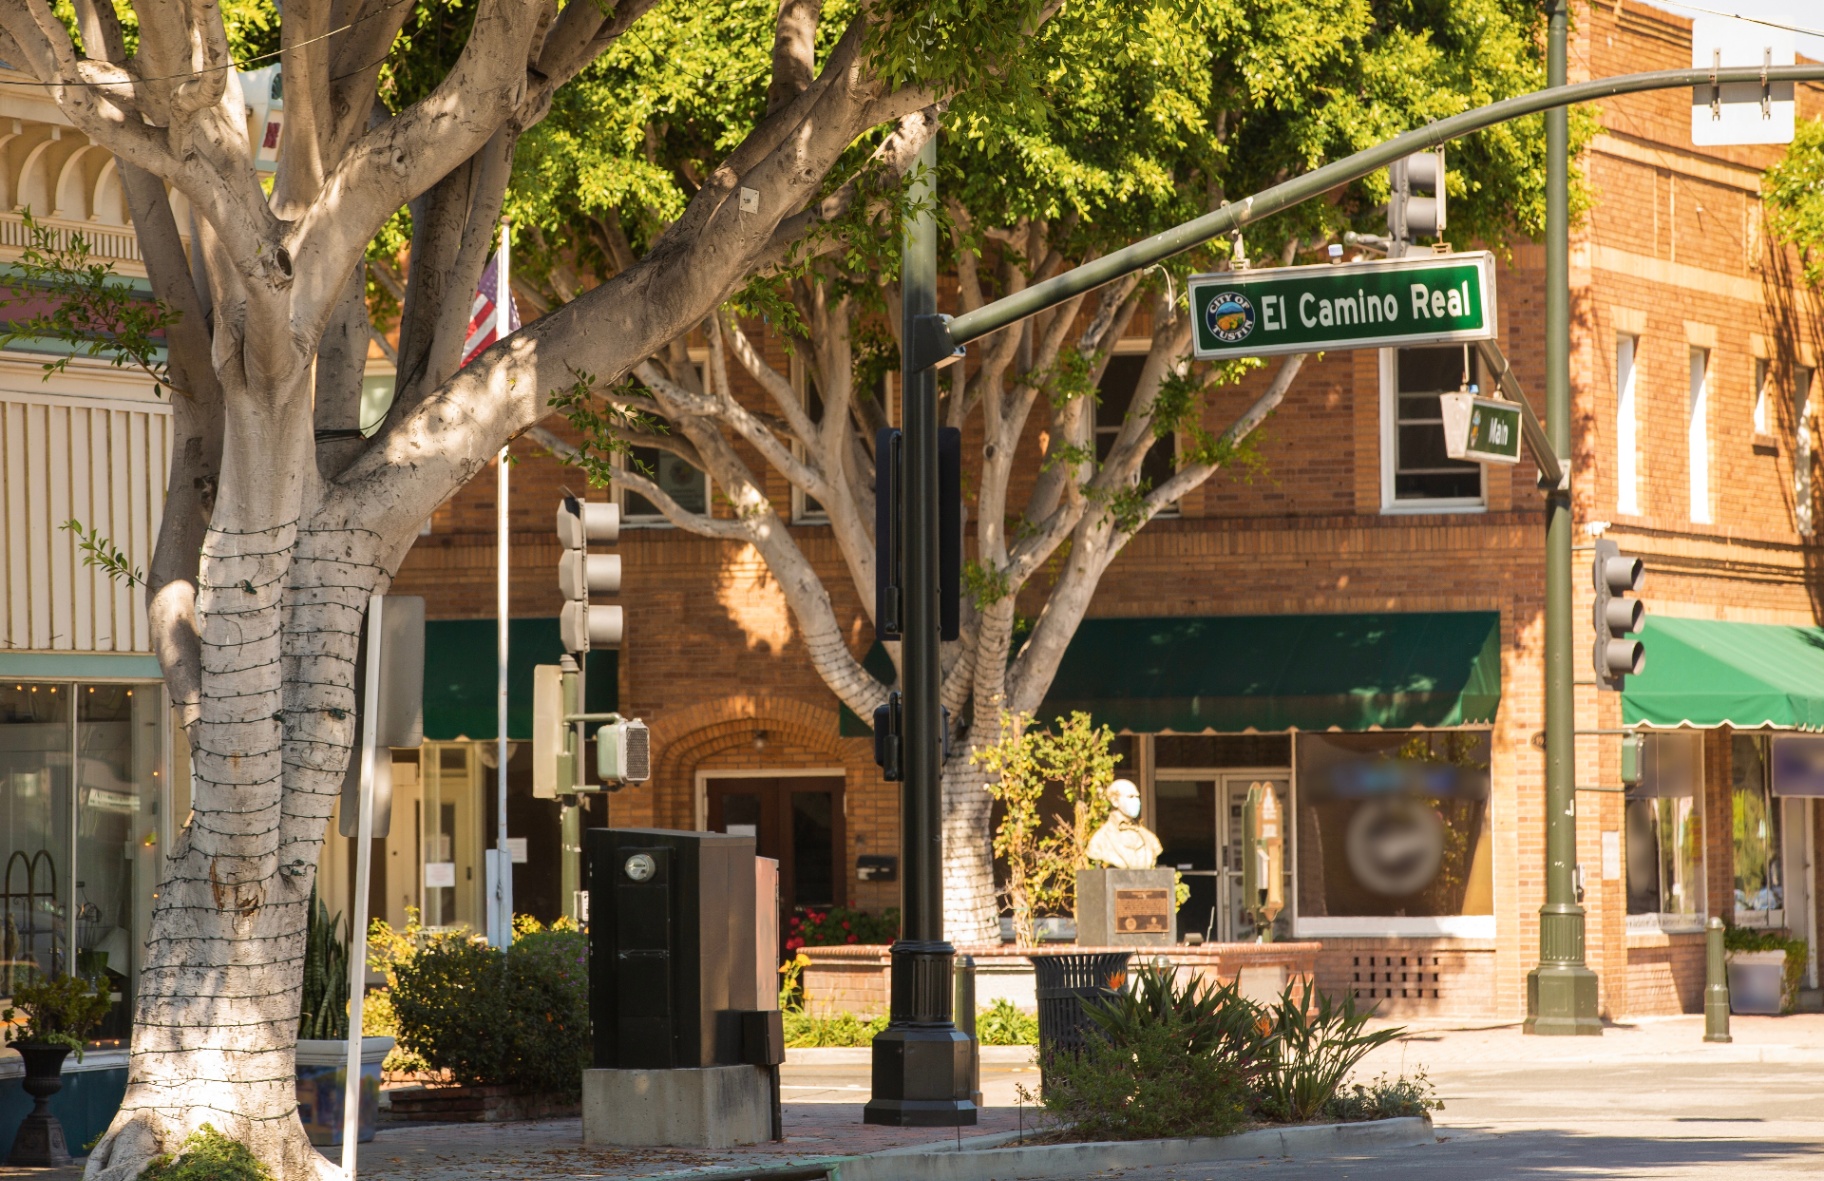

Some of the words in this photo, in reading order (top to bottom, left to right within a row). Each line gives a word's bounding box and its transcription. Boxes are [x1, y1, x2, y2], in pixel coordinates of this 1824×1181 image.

[1209, 294, 1231, 314] CITY
[1234, 295, 1250, 309] OF
[1261, 295, 1287, 331] El
[1299, 288, 1398, 328] Camino
[1410, 280, 1470, 319] Real
[1212, 319, 1253, 340] TUSTIN
[1488, 417, 1509, 446] Main
